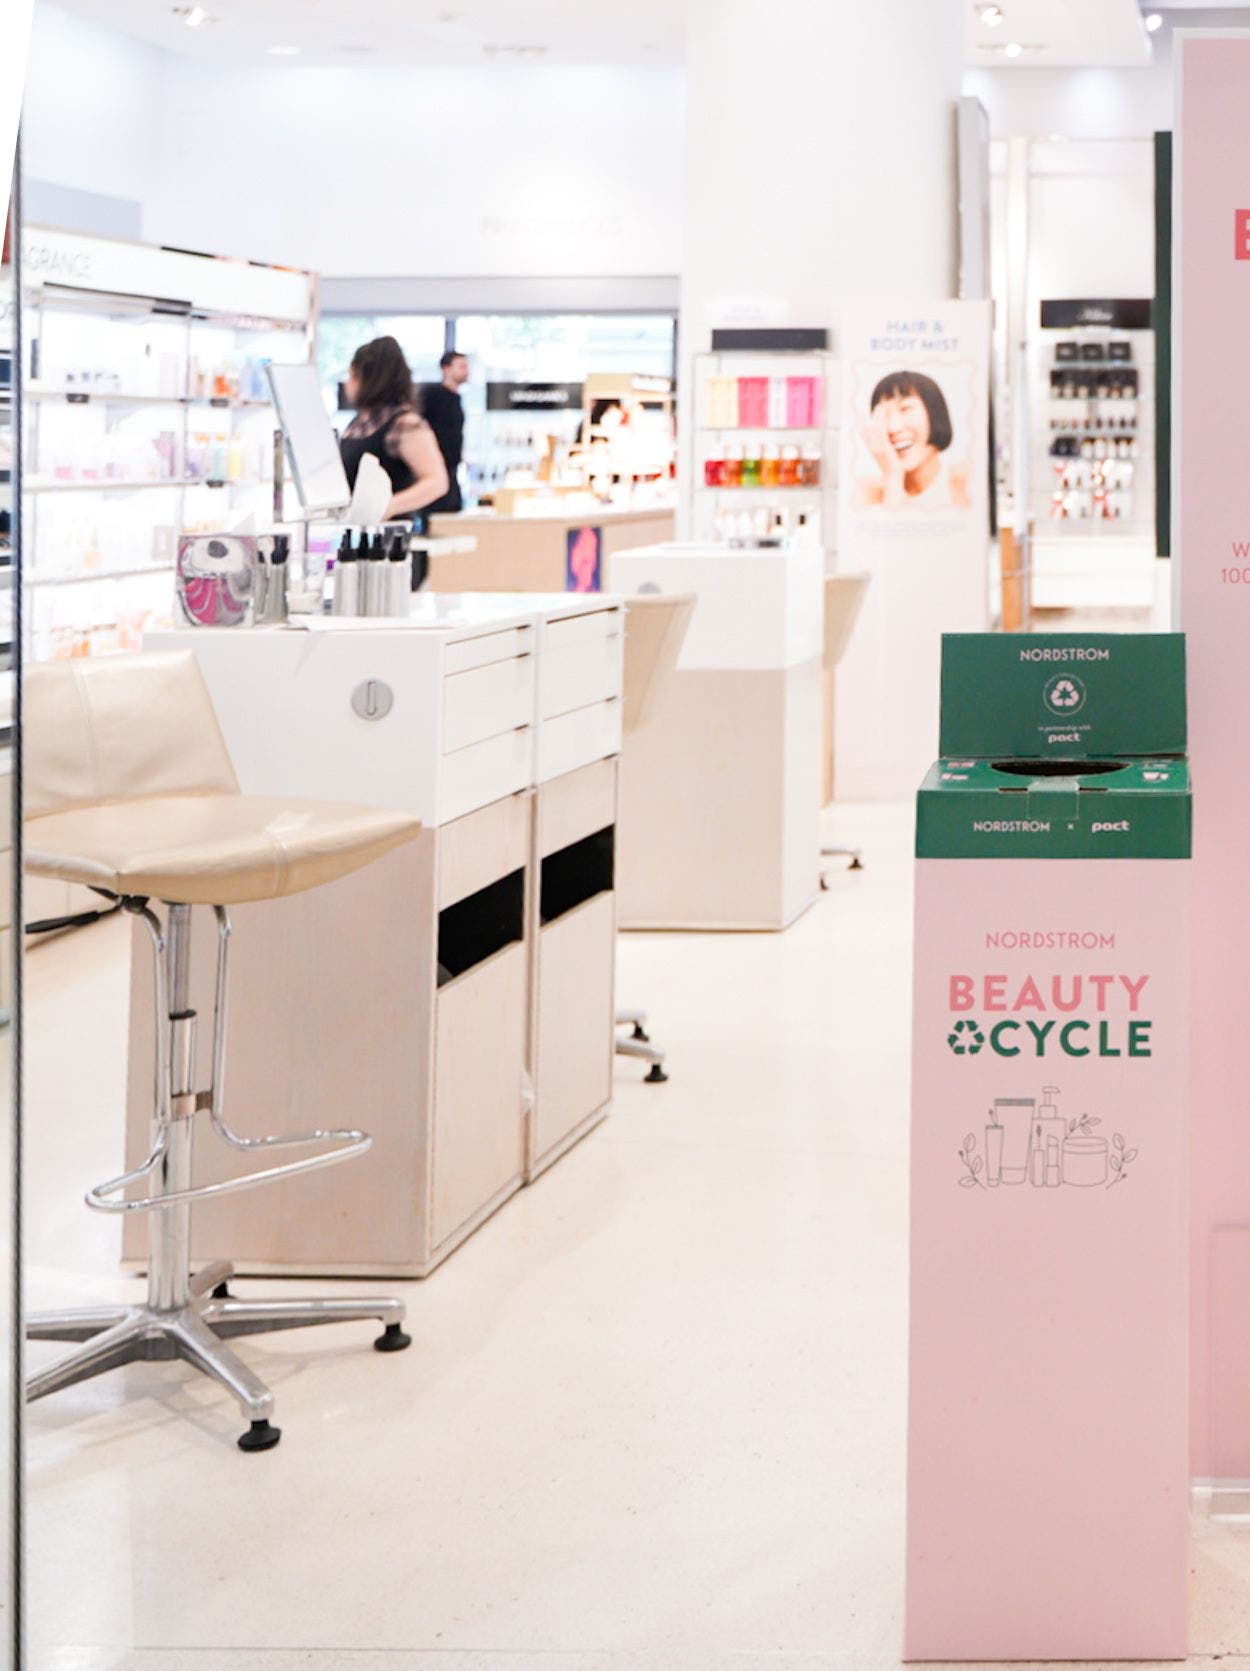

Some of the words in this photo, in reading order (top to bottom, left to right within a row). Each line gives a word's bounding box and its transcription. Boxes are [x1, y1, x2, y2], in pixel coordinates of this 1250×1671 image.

[886, 319, 926, 333] HAIR
[933, 319, 944, 333] &
[870, 338, 915, 352] BODY
[920, 338, 959, 352] MIST
[1020, 648, 1109, 661] NORDSTROM
[1048, 732, 1082, 744] pact
[974, 821, 1050, 832] NORDSTROM
[1092, 821, 1129, 833] pact
[986, 932, 1115, 949] NORDSTROM
[950, 975, 1149, 1012] BEAUTY
[990, 1020, 1152, 1057] CYCLE
